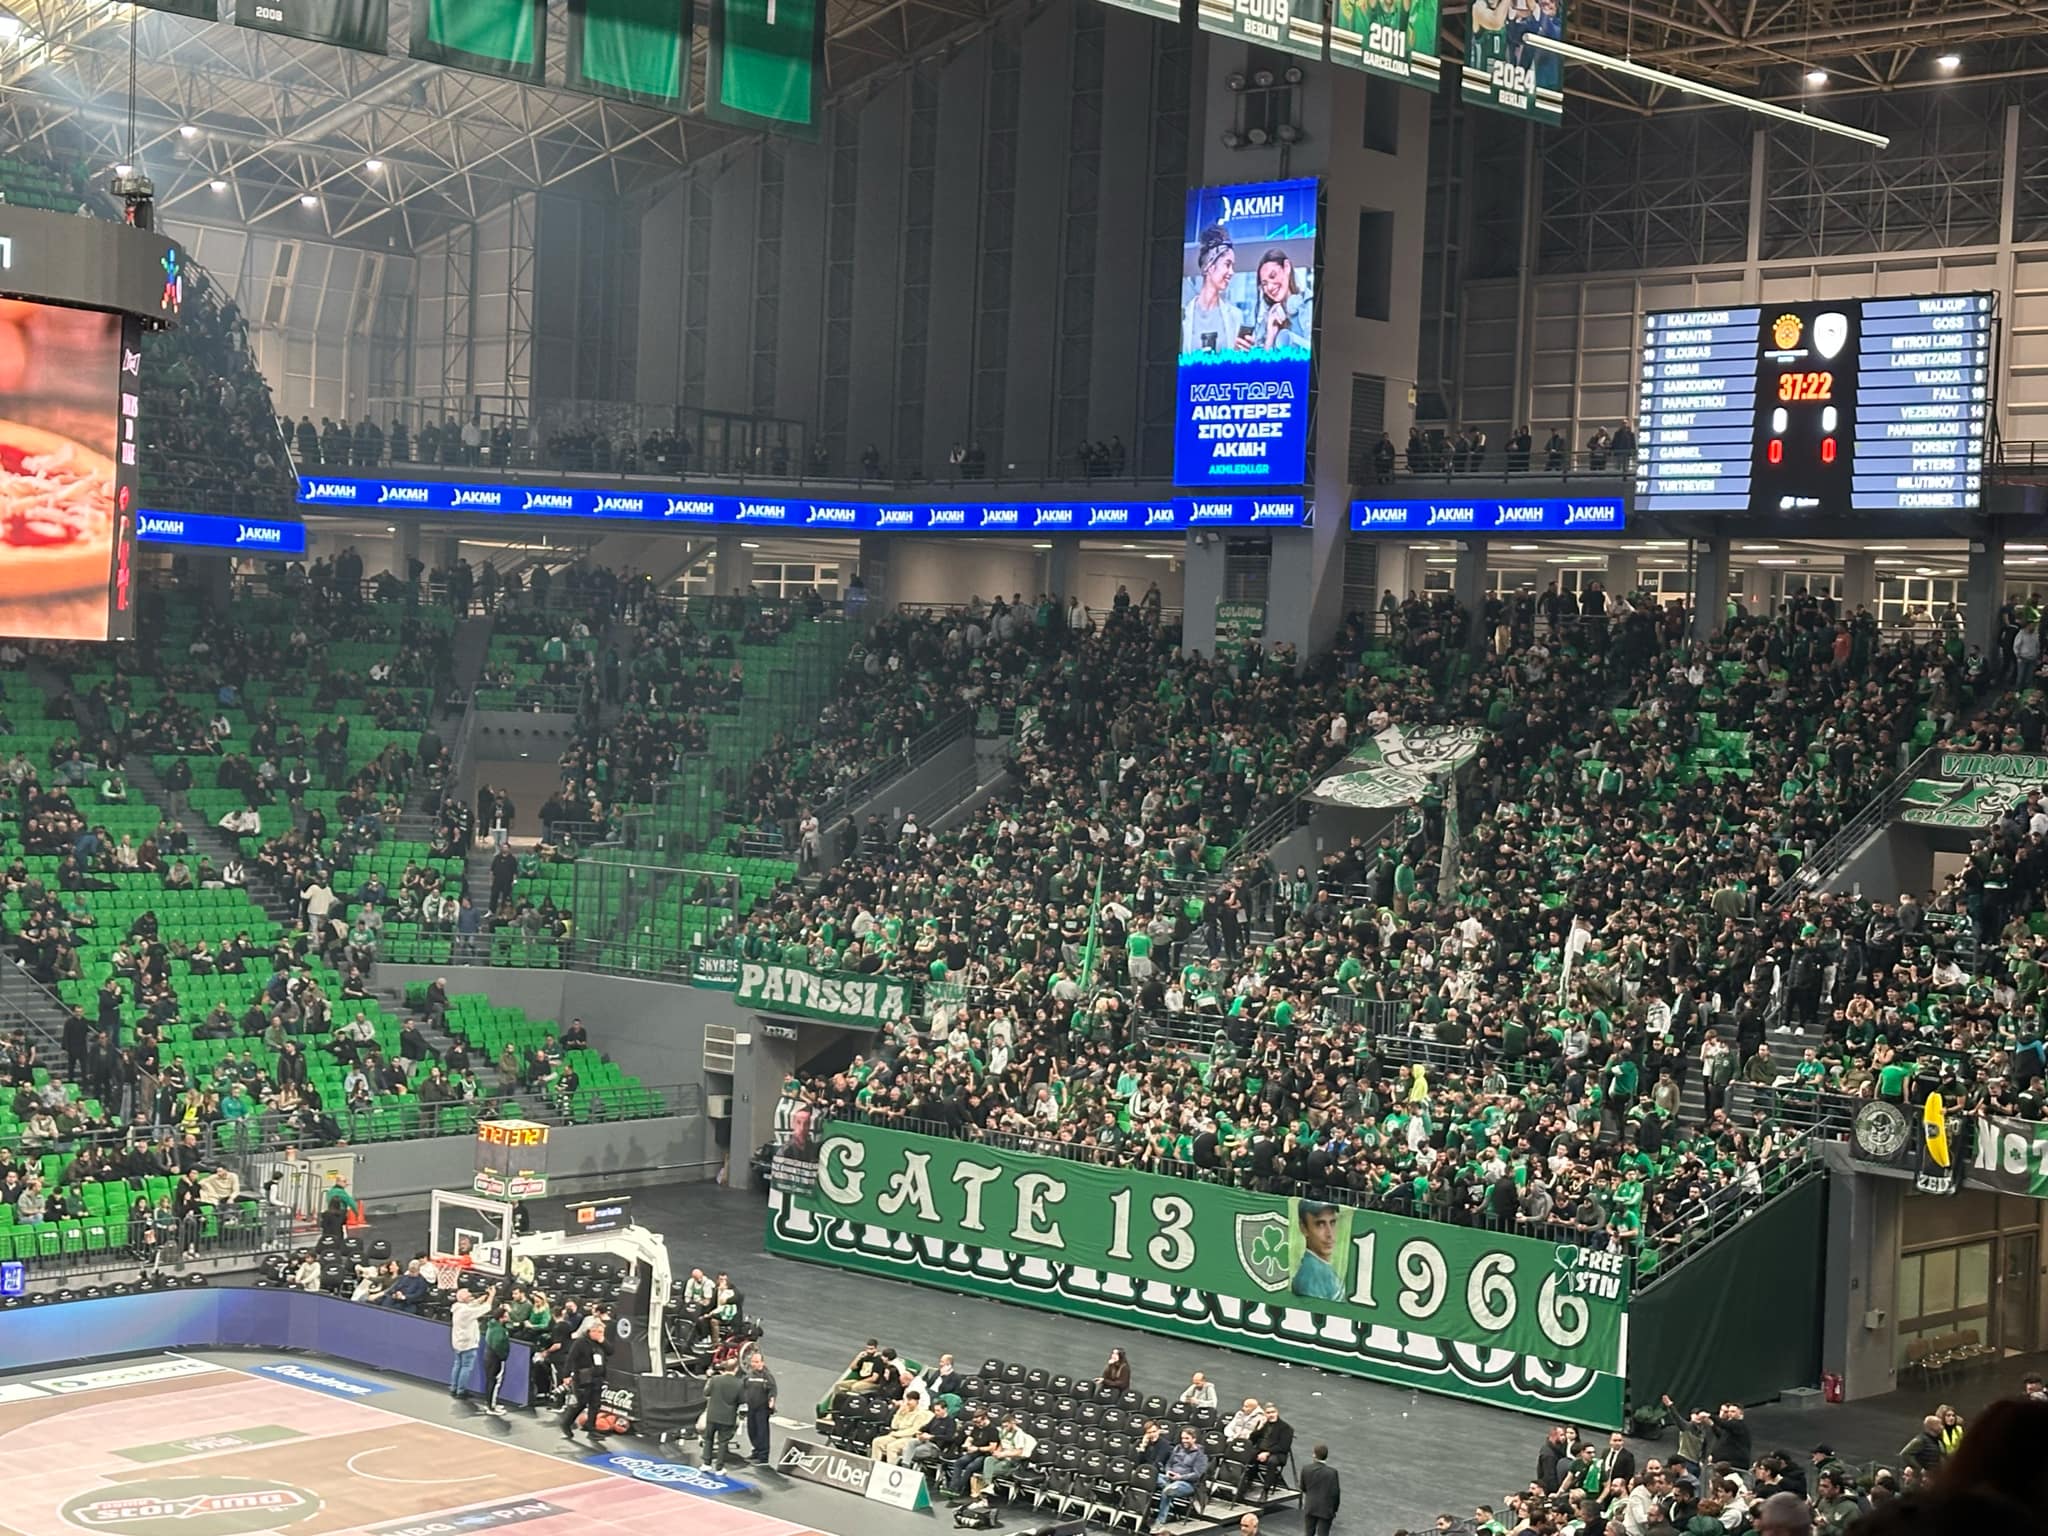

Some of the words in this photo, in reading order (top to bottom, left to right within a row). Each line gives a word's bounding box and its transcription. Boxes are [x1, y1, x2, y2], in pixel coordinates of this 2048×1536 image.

[1243, 19, 1278, 41] BERLIN
[1368, 23, 1406, 57] 2011
[1363, 50, 1409, 77] BARCELONA
[1493, 62, 1536, 94] 2024
[1499, 89, 1527, 110] BERLIN
[1919, 299, 1966, 313] WALKUP
[1932, 317, 1964, 330] GOSS
[1779, 372, 1832, 401] 37:22
[1914, 370, 1961, 384] VILDOZA
[1232, 381, 1294, 400] ΤΩΡΑ
[1932, 387, 1960, 400] FALL
[1192, 403, 1291, 420] ΑΝΩΤΕΡΕΣ
[1661, 413, 1696, 425] GRANT
[1198, 422, 1283, 439] ΣΠΟΥΔΕΣ
[1212, 441, 1266, 458] ΑΚΜΗ
[1768, 439, 1782, 463] 0
[1821, 437, 1836, 463] 0
[1912, 441, 1957, 453] DORSEY
[1912, 459, 1956, 472] PETERS
[739, 964, 905, 1021] PATISSIA
[817, 1136, 1067, 1249] GATE
[1108, 1187, 1196, 1271] 13
[1348, 1228, 1590, 1348] 1966
[1578, 1247, 1623, 1275] FREE
[826, 1456, 870, 1488] Uber
[491, 1502, 552, 1519] PAY
